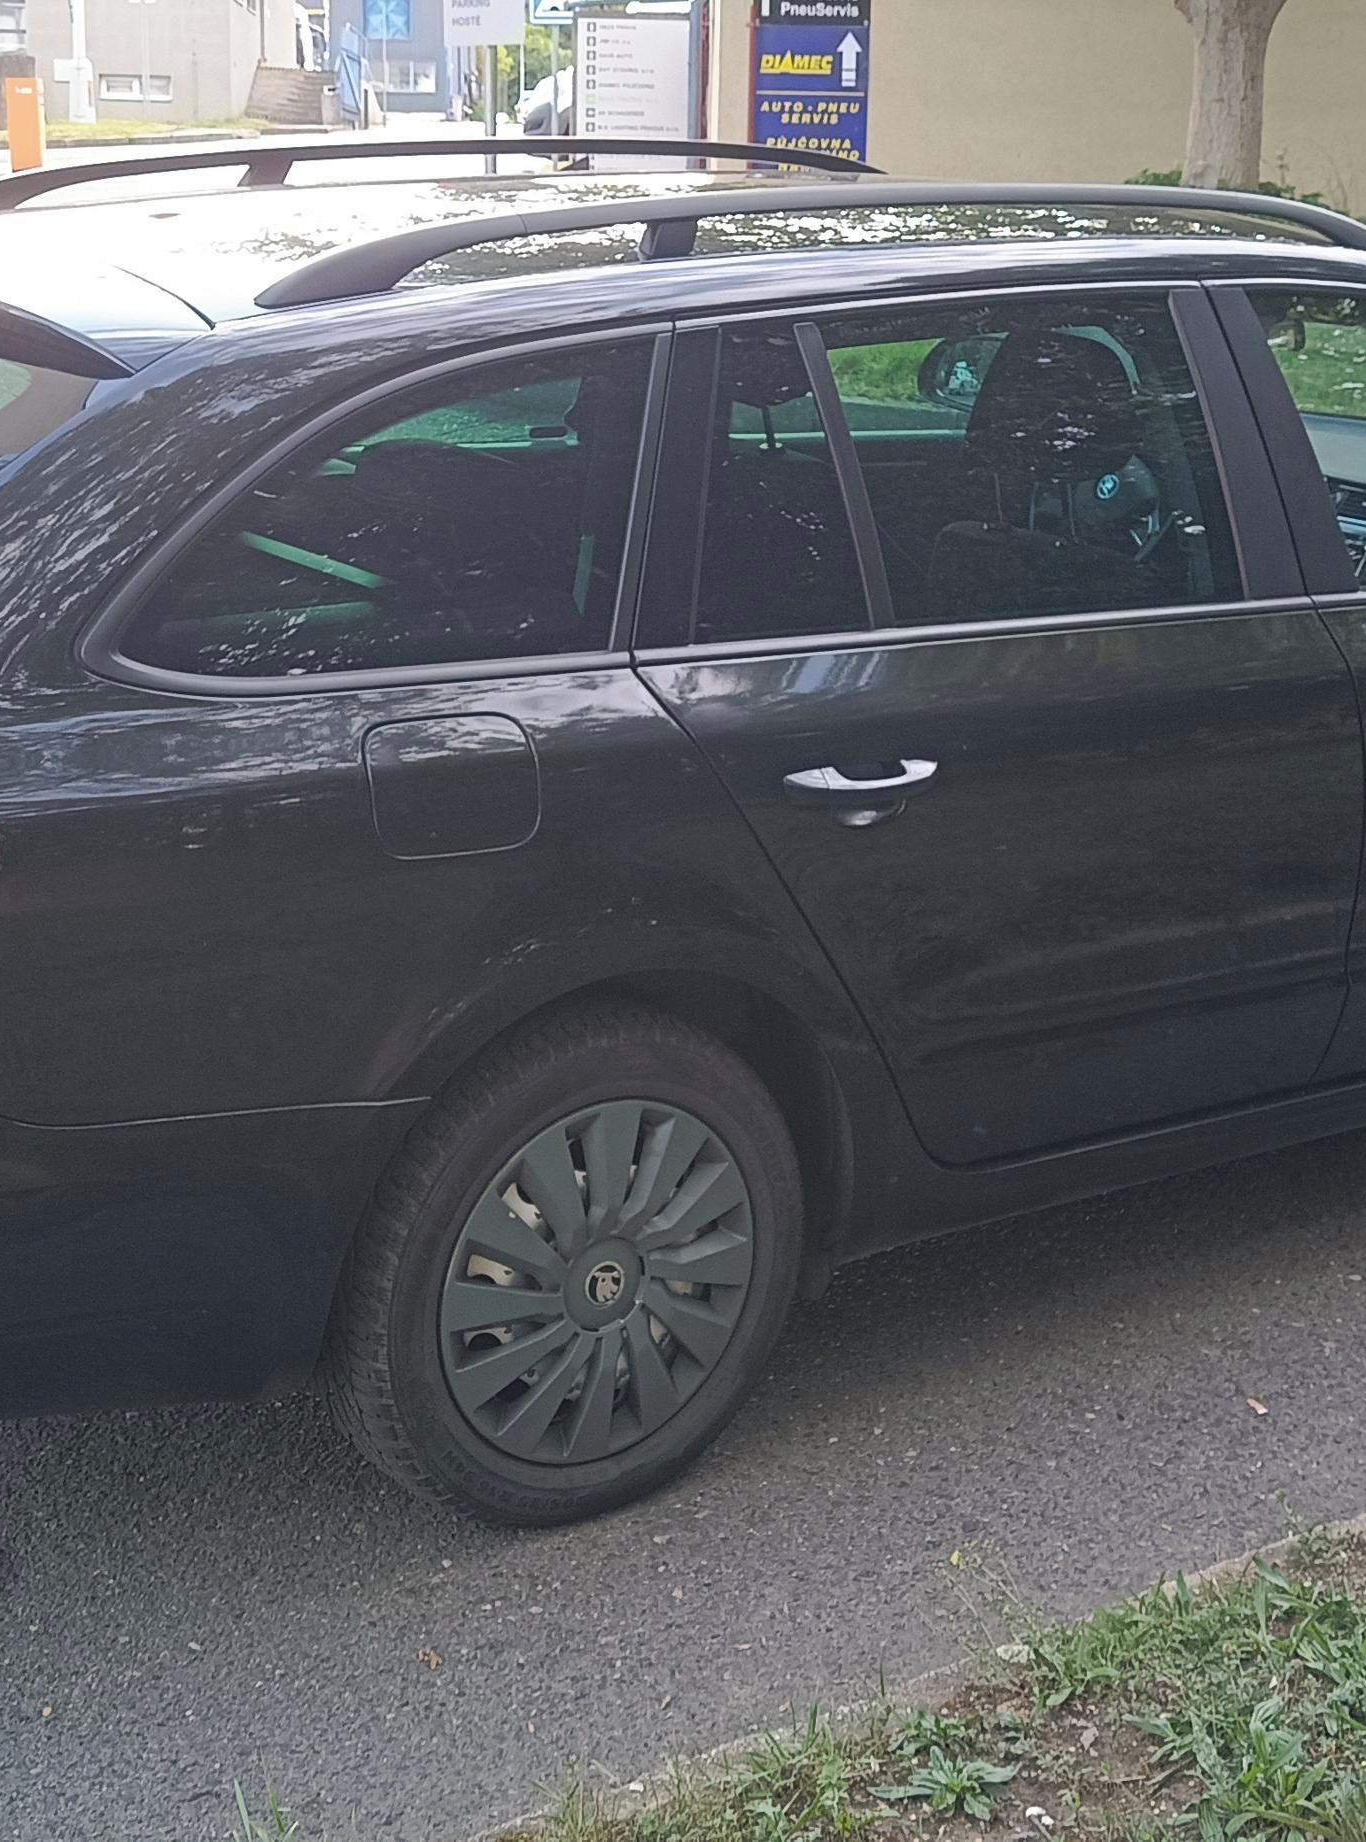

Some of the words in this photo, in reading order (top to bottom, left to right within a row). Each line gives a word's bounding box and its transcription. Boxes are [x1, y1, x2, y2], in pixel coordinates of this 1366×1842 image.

[780, 1, 860, 18] PneuServis
[760, 49, 834, 74] DIAMEC
[760, 101, 804, 112] AUTO
[817, 102, 860, 114] PNEU
[781, 113, 839, 125] SERVIS
